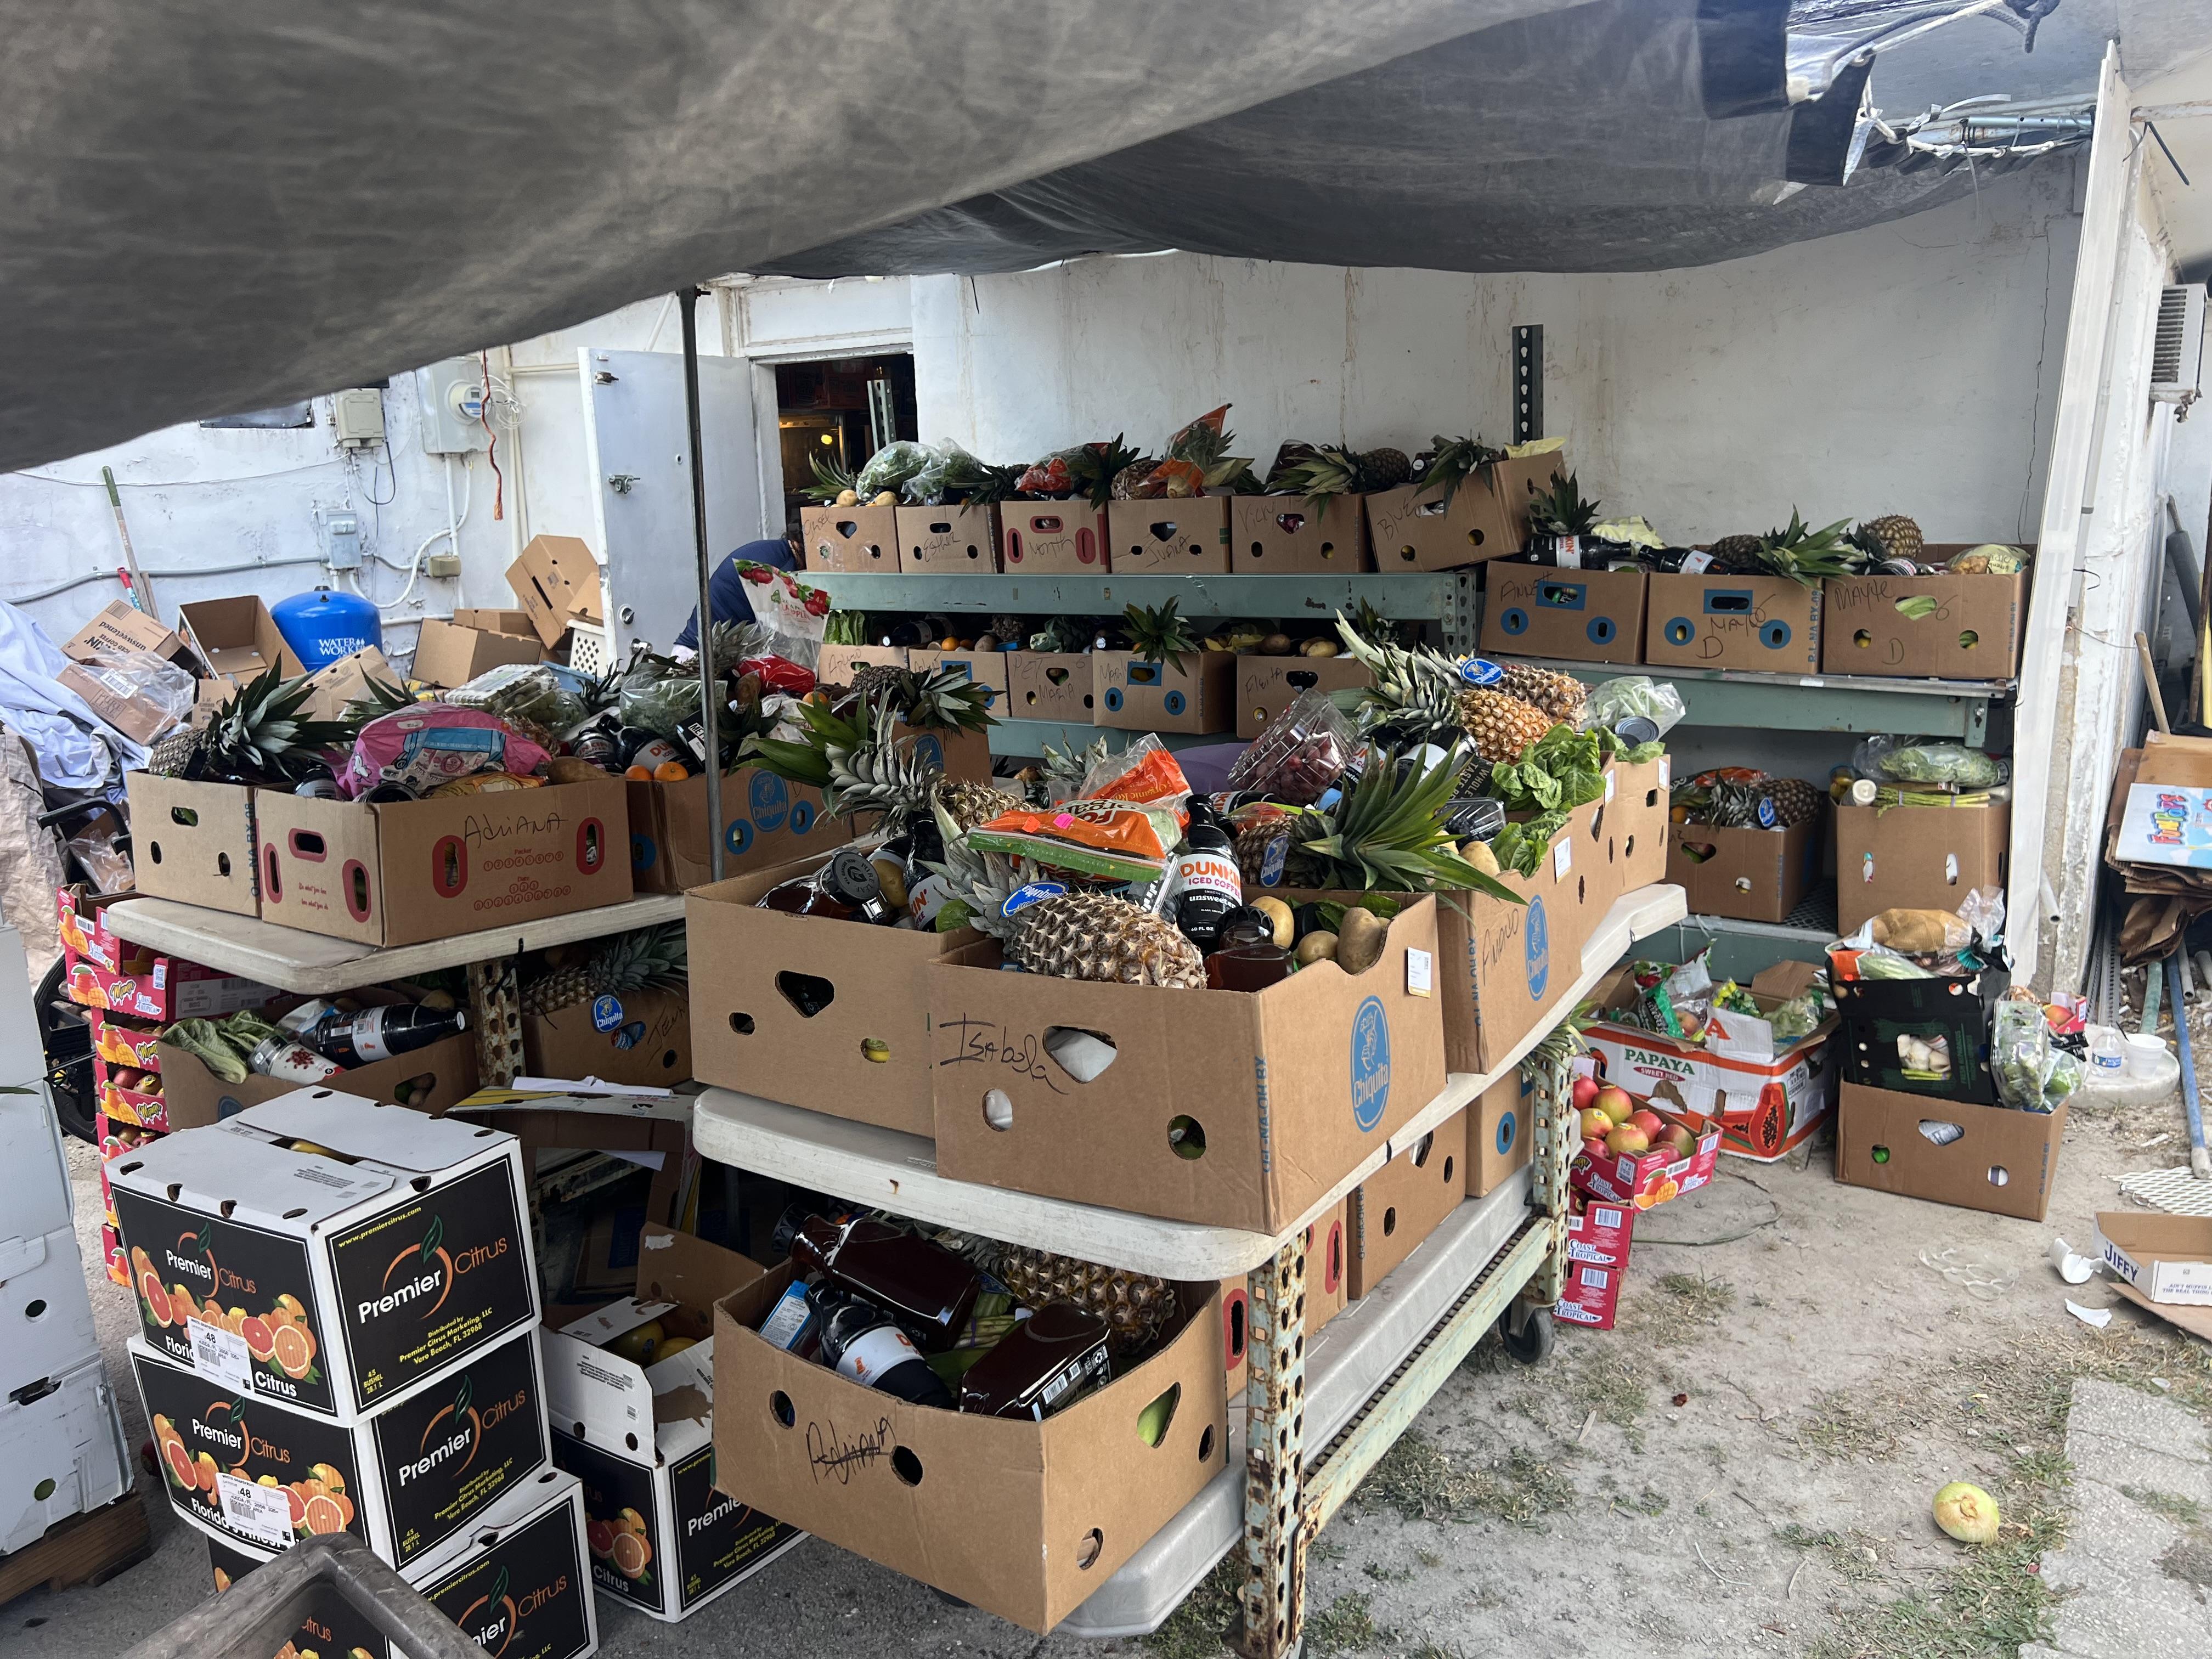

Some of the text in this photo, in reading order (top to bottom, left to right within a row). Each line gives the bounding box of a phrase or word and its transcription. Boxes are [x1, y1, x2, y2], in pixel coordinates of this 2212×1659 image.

[98, 621, 147, 651] unsweetened
[319, 638, 356, 647] WATER
[1695, 636, 1723, 659] D
[1882, 637, 1904, 665] D
[99, 693, 123, 710] PURE
[1465, 768, 1491, 797] WHOLE
[753, 799, 787, 820] Chiquita
[861, 862, 876, 884] PURE
[1261, 859, 1284, 878] Chiquita
[856, 883, 875, 894] LEAF
[1189, 877, 1212, 885] ICED
[89, 940, 104, 954] COAST
[137, 992, 152, 1004] COAST
[597, 1012, 623, 1028] Chiquita
[1624, 1048, 1695, 1075] PAPAYA
[1354, 1062, 1389, 1109] Chiquita
[1640, 1067, 1679, 1082] SWEET RED
[1592, 1173, 1612, 1189] COAST
[338, 1206, 422, 1248] www.premiercitrus.com
[455, 1237, 507, 1274] Citrus
[1569, 1249, 1607, 1262] TROPICAL
[1570, 1240, 1595, 1251] COAST
[166, 1249, 257, 1294] Premier Citrus
[358, 1269, 442, 1324] Premier
[1556, 1299, 1582, 1310] COAST
[1555, 1307, 1594, 1322] TROPICAL
[206, 1332, 216, 1344] 48
[399, 1307, 493, 1363] Premier Citrus Marketing, LLC
[428, 1316, 465, 1338] Distributed by
[413, 1323, 483, 1365] Vero Beach, FL 32968
[255, 1370, 297, 1397] Citrus
[363, 1373, 384, 1389] BUSHEL
[366, 1384, 379, 1395] 28.1
[482, 1389, 527, 1430] Citrus
[192, 1418, 291, 1464] Premier Citrus
[399, 1427, 471, 1487] Premier
[239, 1487, 252, 1498] 48
[435, 1500, 458, 1520] Premier
[459, 1489, 475, 1503] Citrus
[503, 1457, 514, 1469] LLC
[459, 1469, 490, 1494] Distributed by
[447, 1508, 461, 1521] Vero
[480, 1487, 488, 1496] FL
[488, 1472, 505, 1489] 32968
[402, 1532, 421, 1547] BUSHEL
[404, 1542, 415, 1553] 28.1
[593, 1564, 630, 1593] Citrus
[517, 1575, 568, 1617] Citrus
